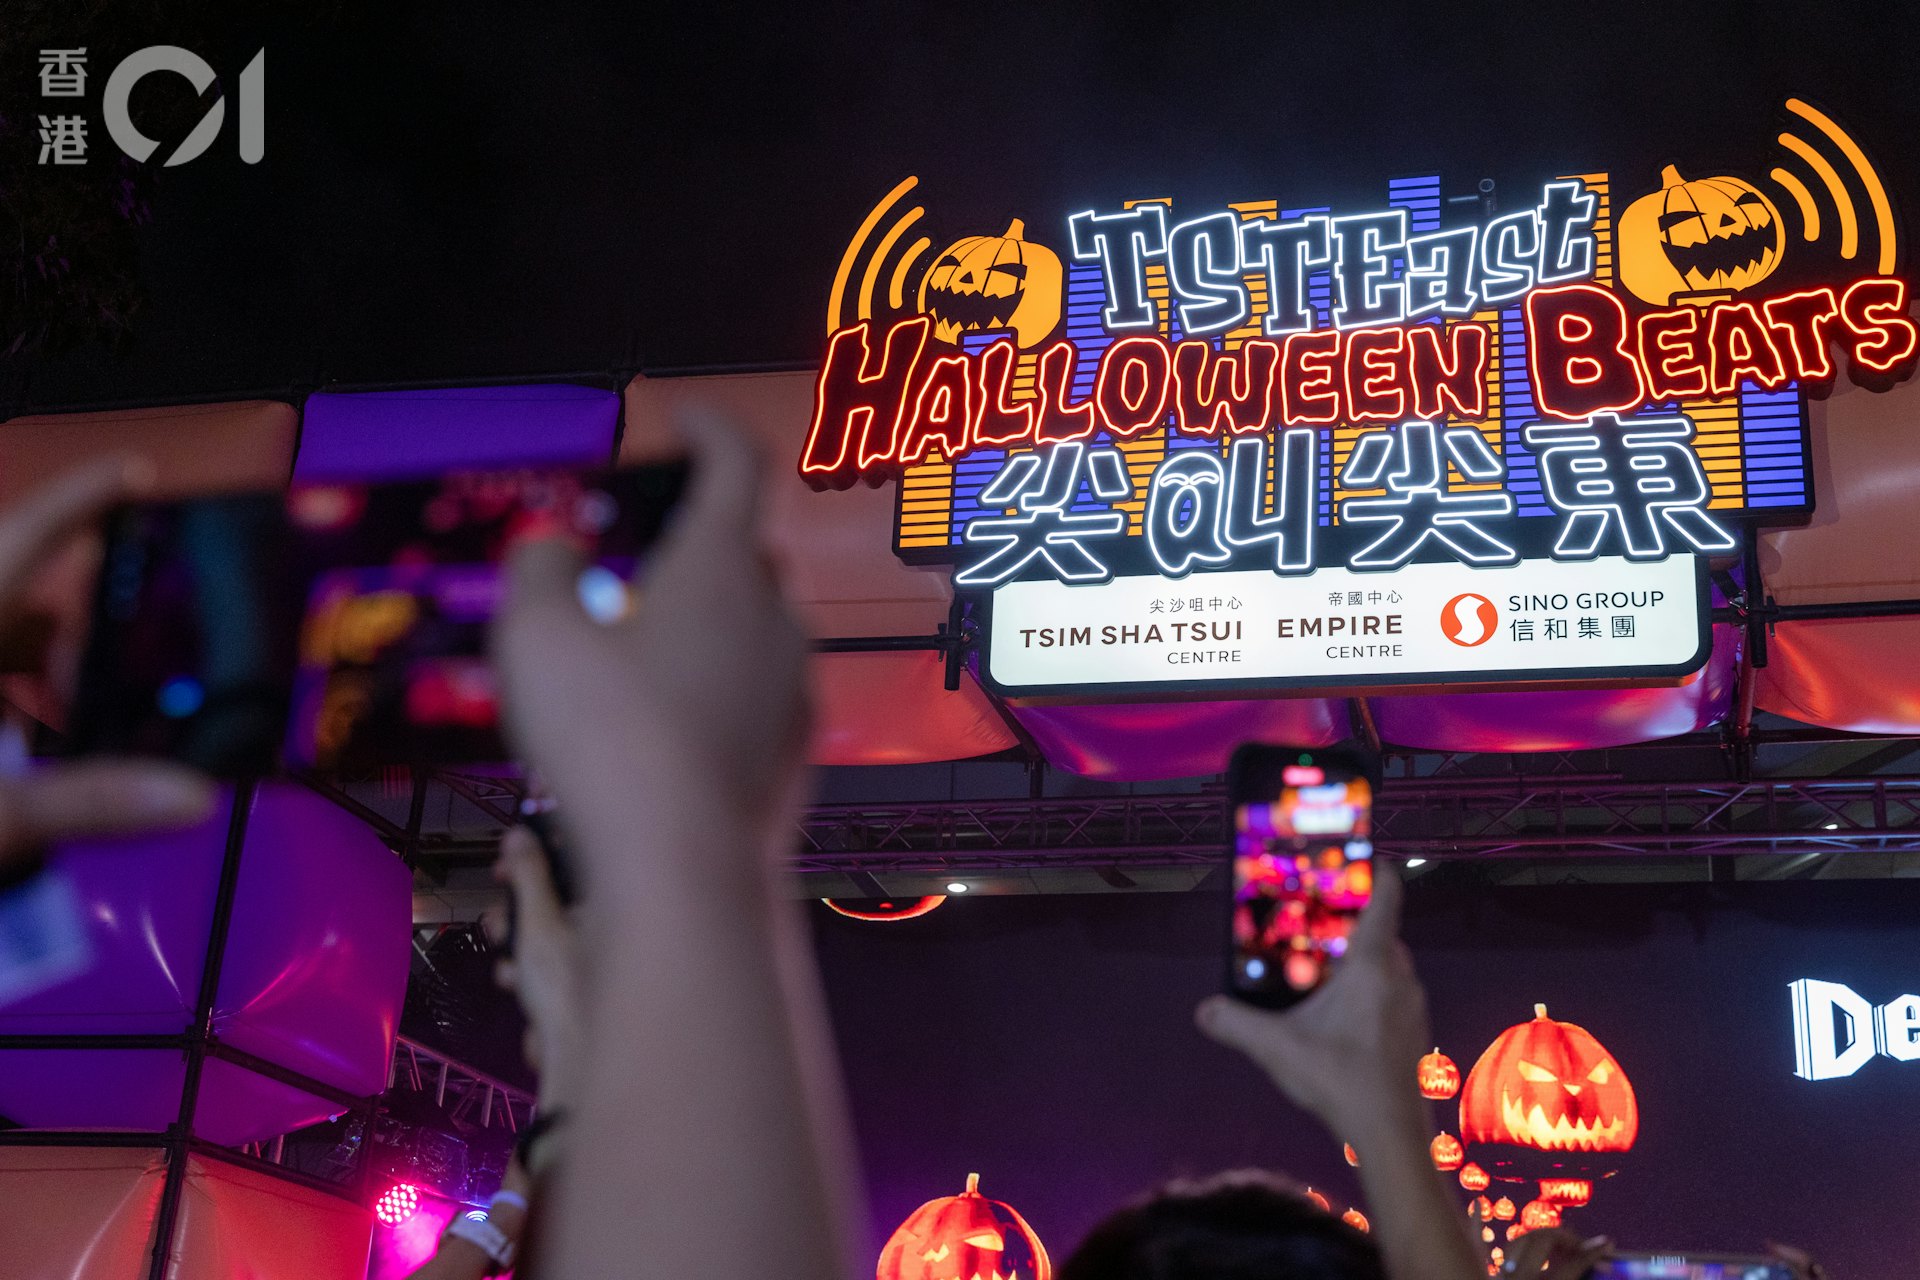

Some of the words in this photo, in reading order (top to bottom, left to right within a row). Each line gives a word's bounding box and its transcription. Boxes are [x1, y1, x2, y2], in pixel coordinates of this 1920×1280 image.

[801, 316, 1488, 472] HALLOWEEN
[1526, 279, 1917, 420] BEATS
[1149, 596, 1243, 614] 尖沙咀中心
[1328, 589, 1403, 607] 帝國中心
[1509, 593, 1568, 612] SINO
[1576, 591, 1665, 610] GROUP
[1020, 626, 1091, 648] TSIM
[1101, 623, 1164, 645] SHA
[1171, 620, 1242, 643] TSUI
[1278, 614, 1402, 638] EMPIRE
[1509, 615, 1636, 643] 信和集團
[1167, 650, 1242, 665] CENTRE
[1326, 644, 1403, 659] CENTRE
